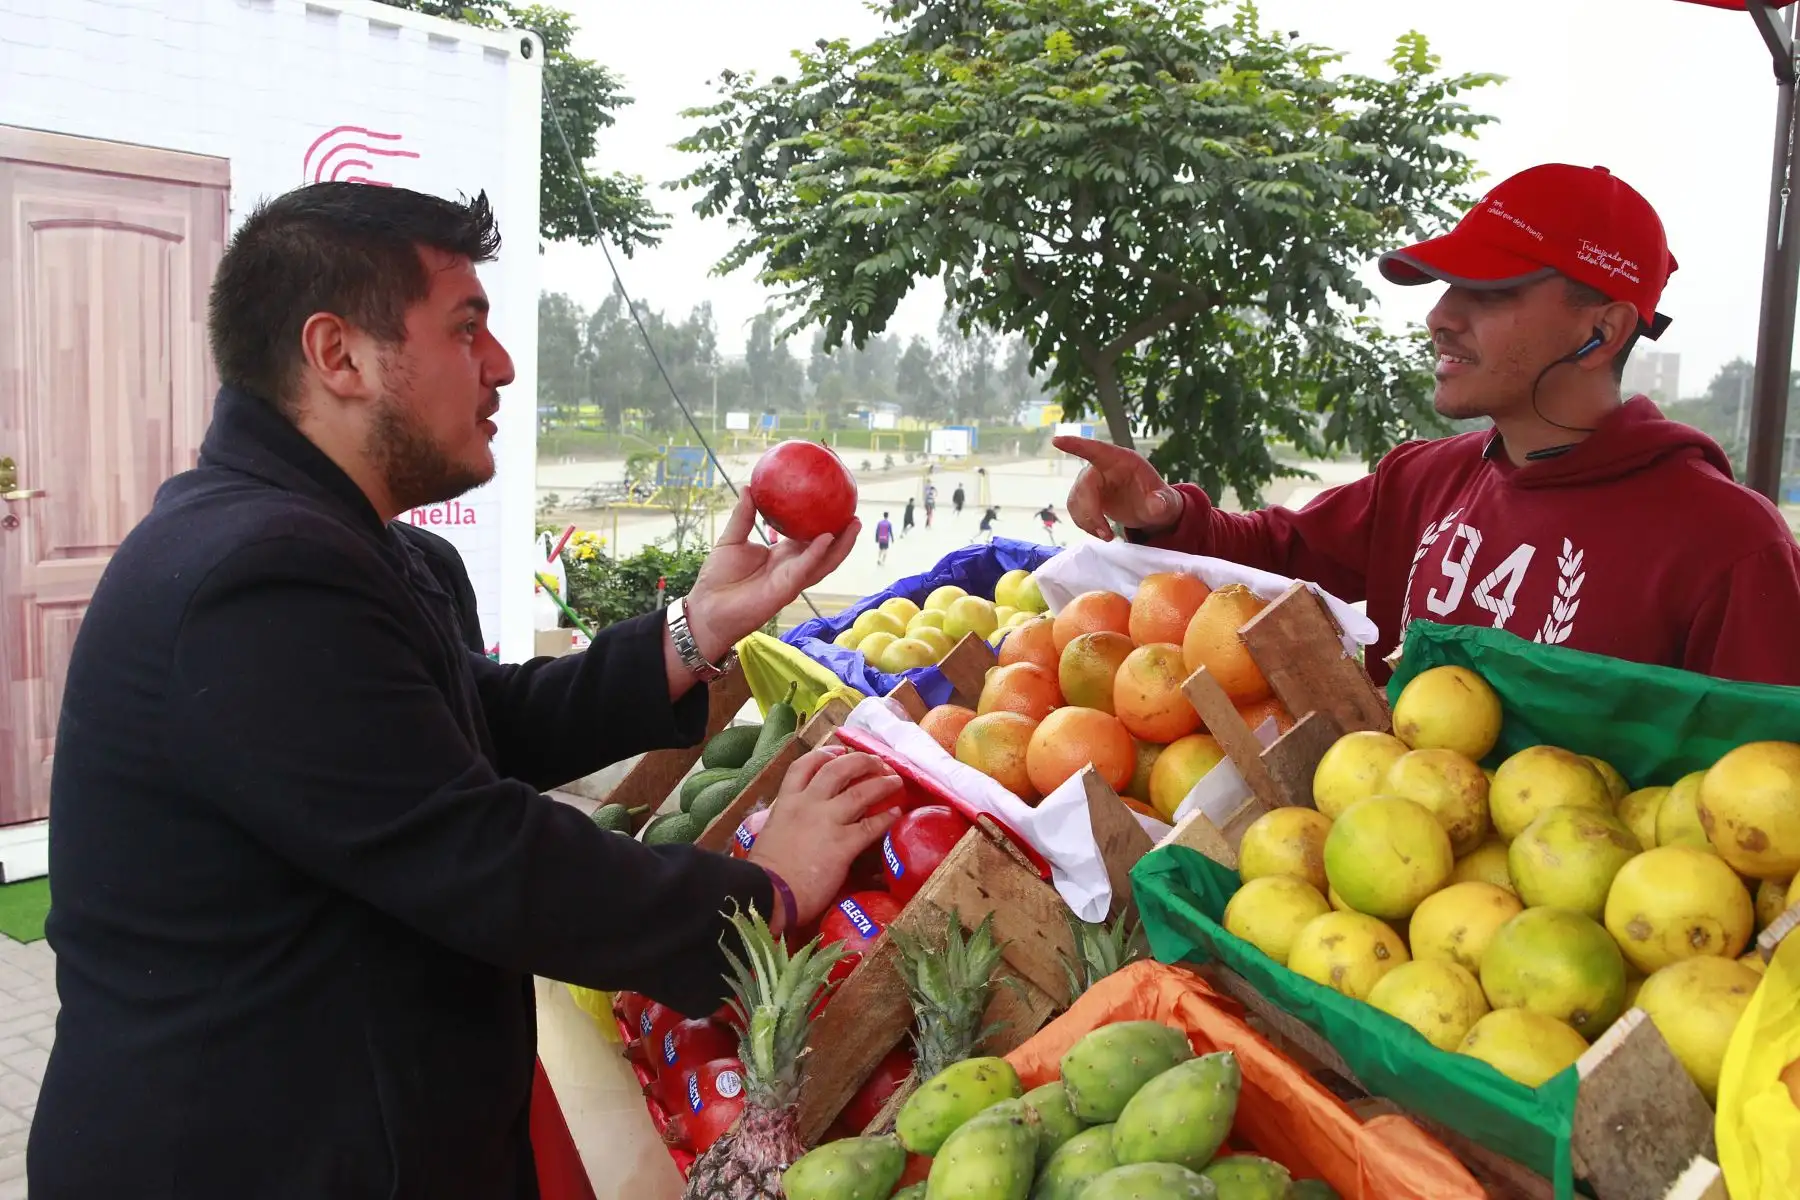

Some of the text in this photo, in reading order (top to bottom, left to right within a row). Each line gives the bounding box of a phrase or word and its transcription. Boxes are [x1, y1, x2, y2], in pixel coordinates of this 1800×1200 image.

[1512, 218, 1526, 228] deja
[1525, 225, 1544, 242] huella
[1576, 250, 1599, 265] todos
[1599, 257, 1613, 271] los
[1620, 259, 1639, 271] para
[1427, 523, 1537, 630] 94
[840, 899, 872, 934] SELECTA
